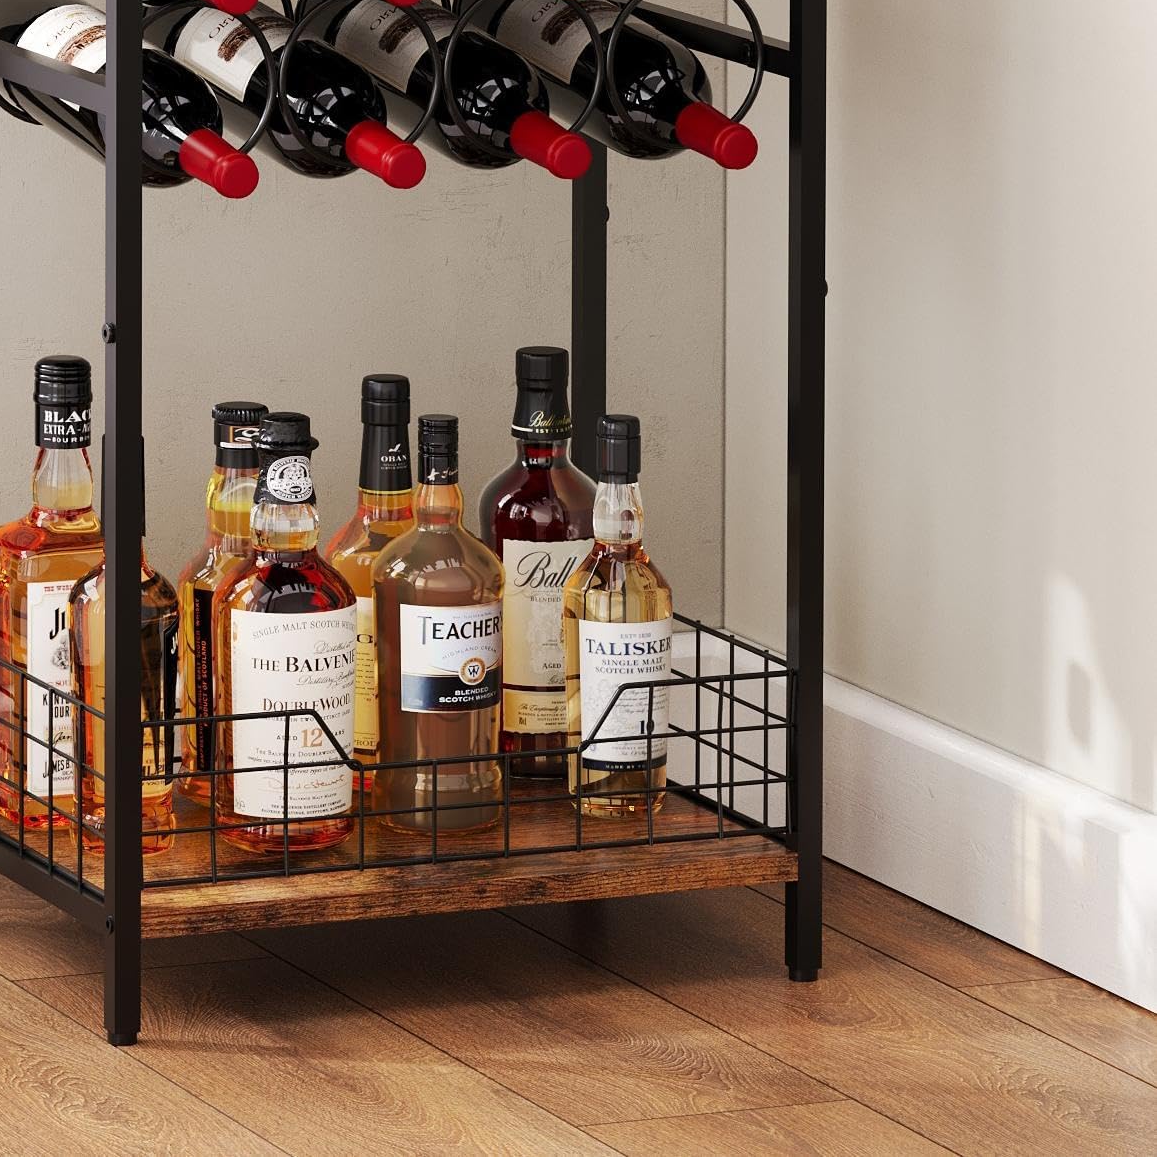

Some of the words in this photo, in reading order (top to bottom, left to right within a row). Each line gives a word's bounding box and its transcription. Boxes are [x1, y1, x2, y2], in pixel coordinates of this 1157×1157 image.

[282, 621, 308, 632] MALT
[585, 636, 671, 656] TALISKER
[252, 657, 280, 672] THE
[602, 658, 639, 667] SINGLE
[642, 656, 663, 666] MALT
[594, 666, 634, 675] SCOTCH
[637, 663, 666, 674] WHISKY
[454, 686, 489, 696] BLENDED
[475, 691, 497, 701] WHISKY
[300, 727, 324, 749] 12
